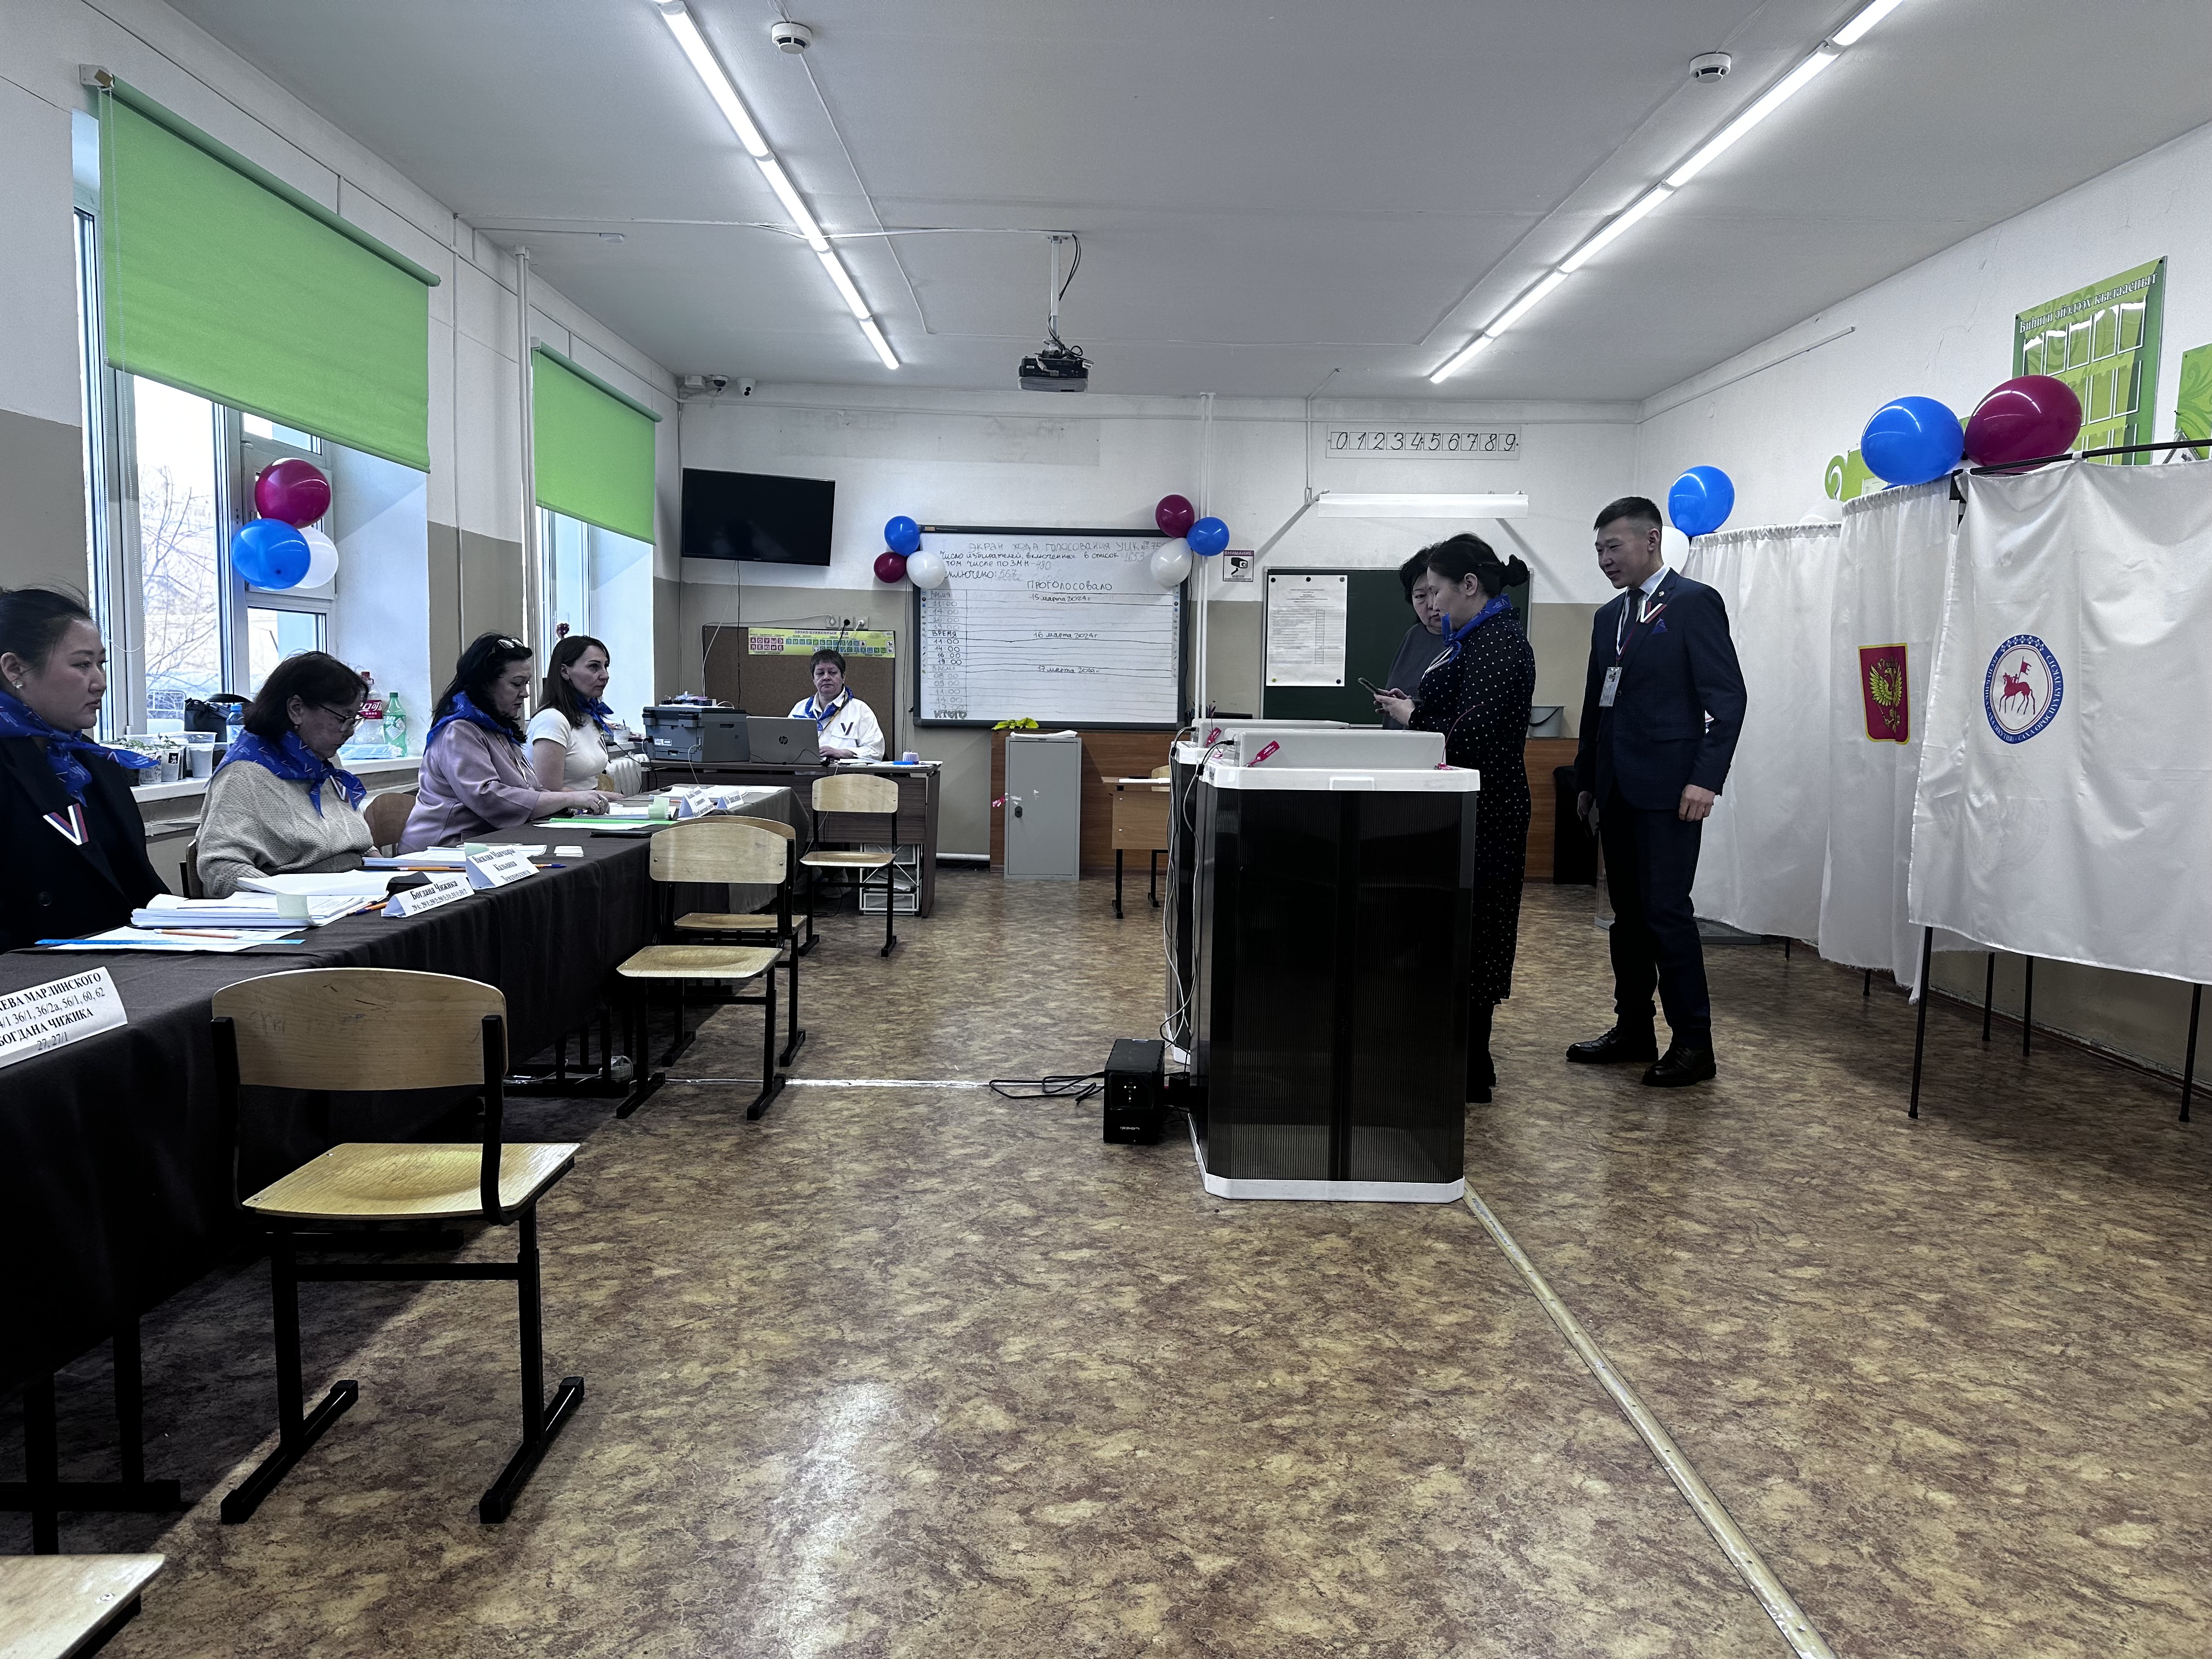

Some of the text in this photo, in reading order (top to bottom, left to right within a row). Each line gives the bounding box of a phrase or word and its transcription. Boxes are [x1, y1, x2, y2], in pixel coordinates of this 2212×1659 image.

[1124, 552, 1145, 562] 1653
[24, 972, 101, 1003] МАРЛИНСКОГО
[95, 987, 105, 998] 62
[48, 1007, 94, 1029] ЧИЖИКА
